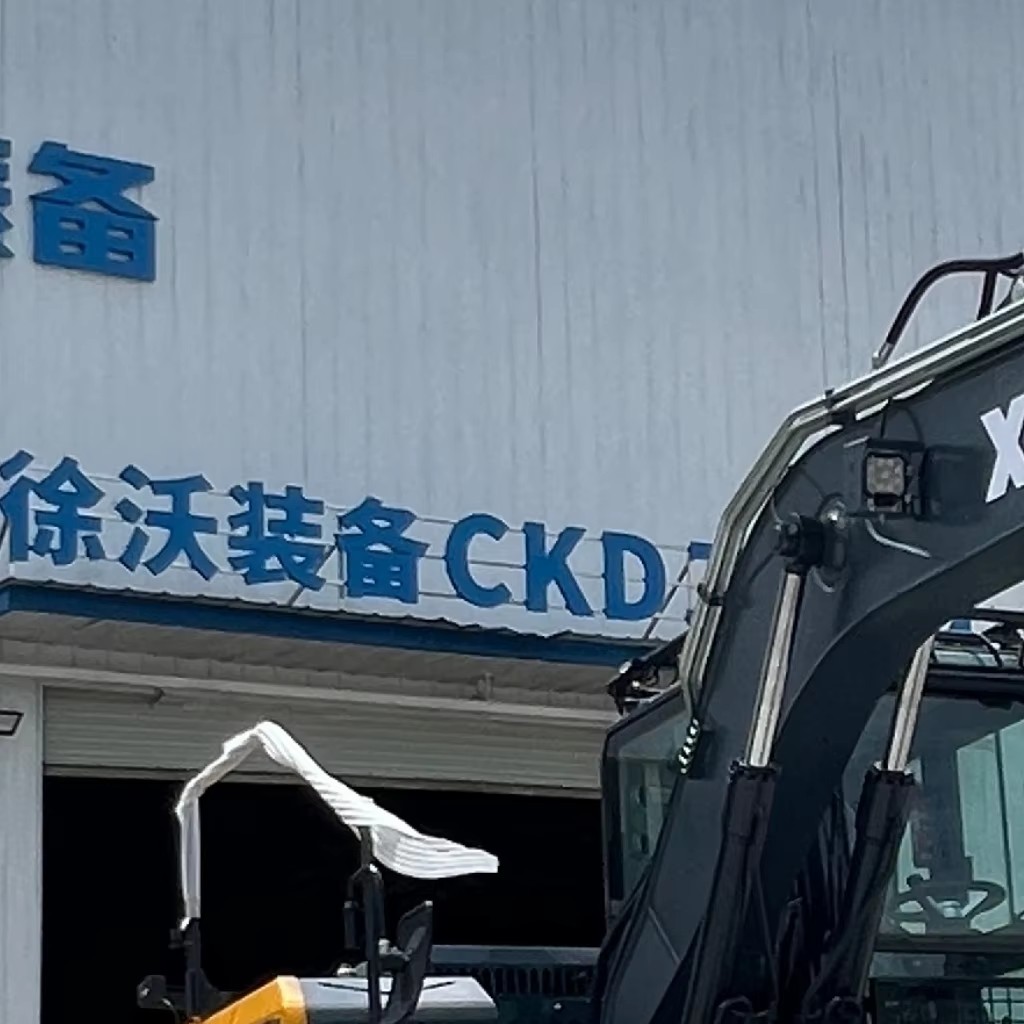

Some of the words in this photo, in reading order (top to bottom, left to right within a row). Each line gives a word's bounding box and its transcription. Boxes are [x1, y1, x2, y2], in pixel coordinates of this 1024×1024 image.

[0, 138, 160, 283] 备
[0, 449, 714, 626] 徐沃装备CKD
